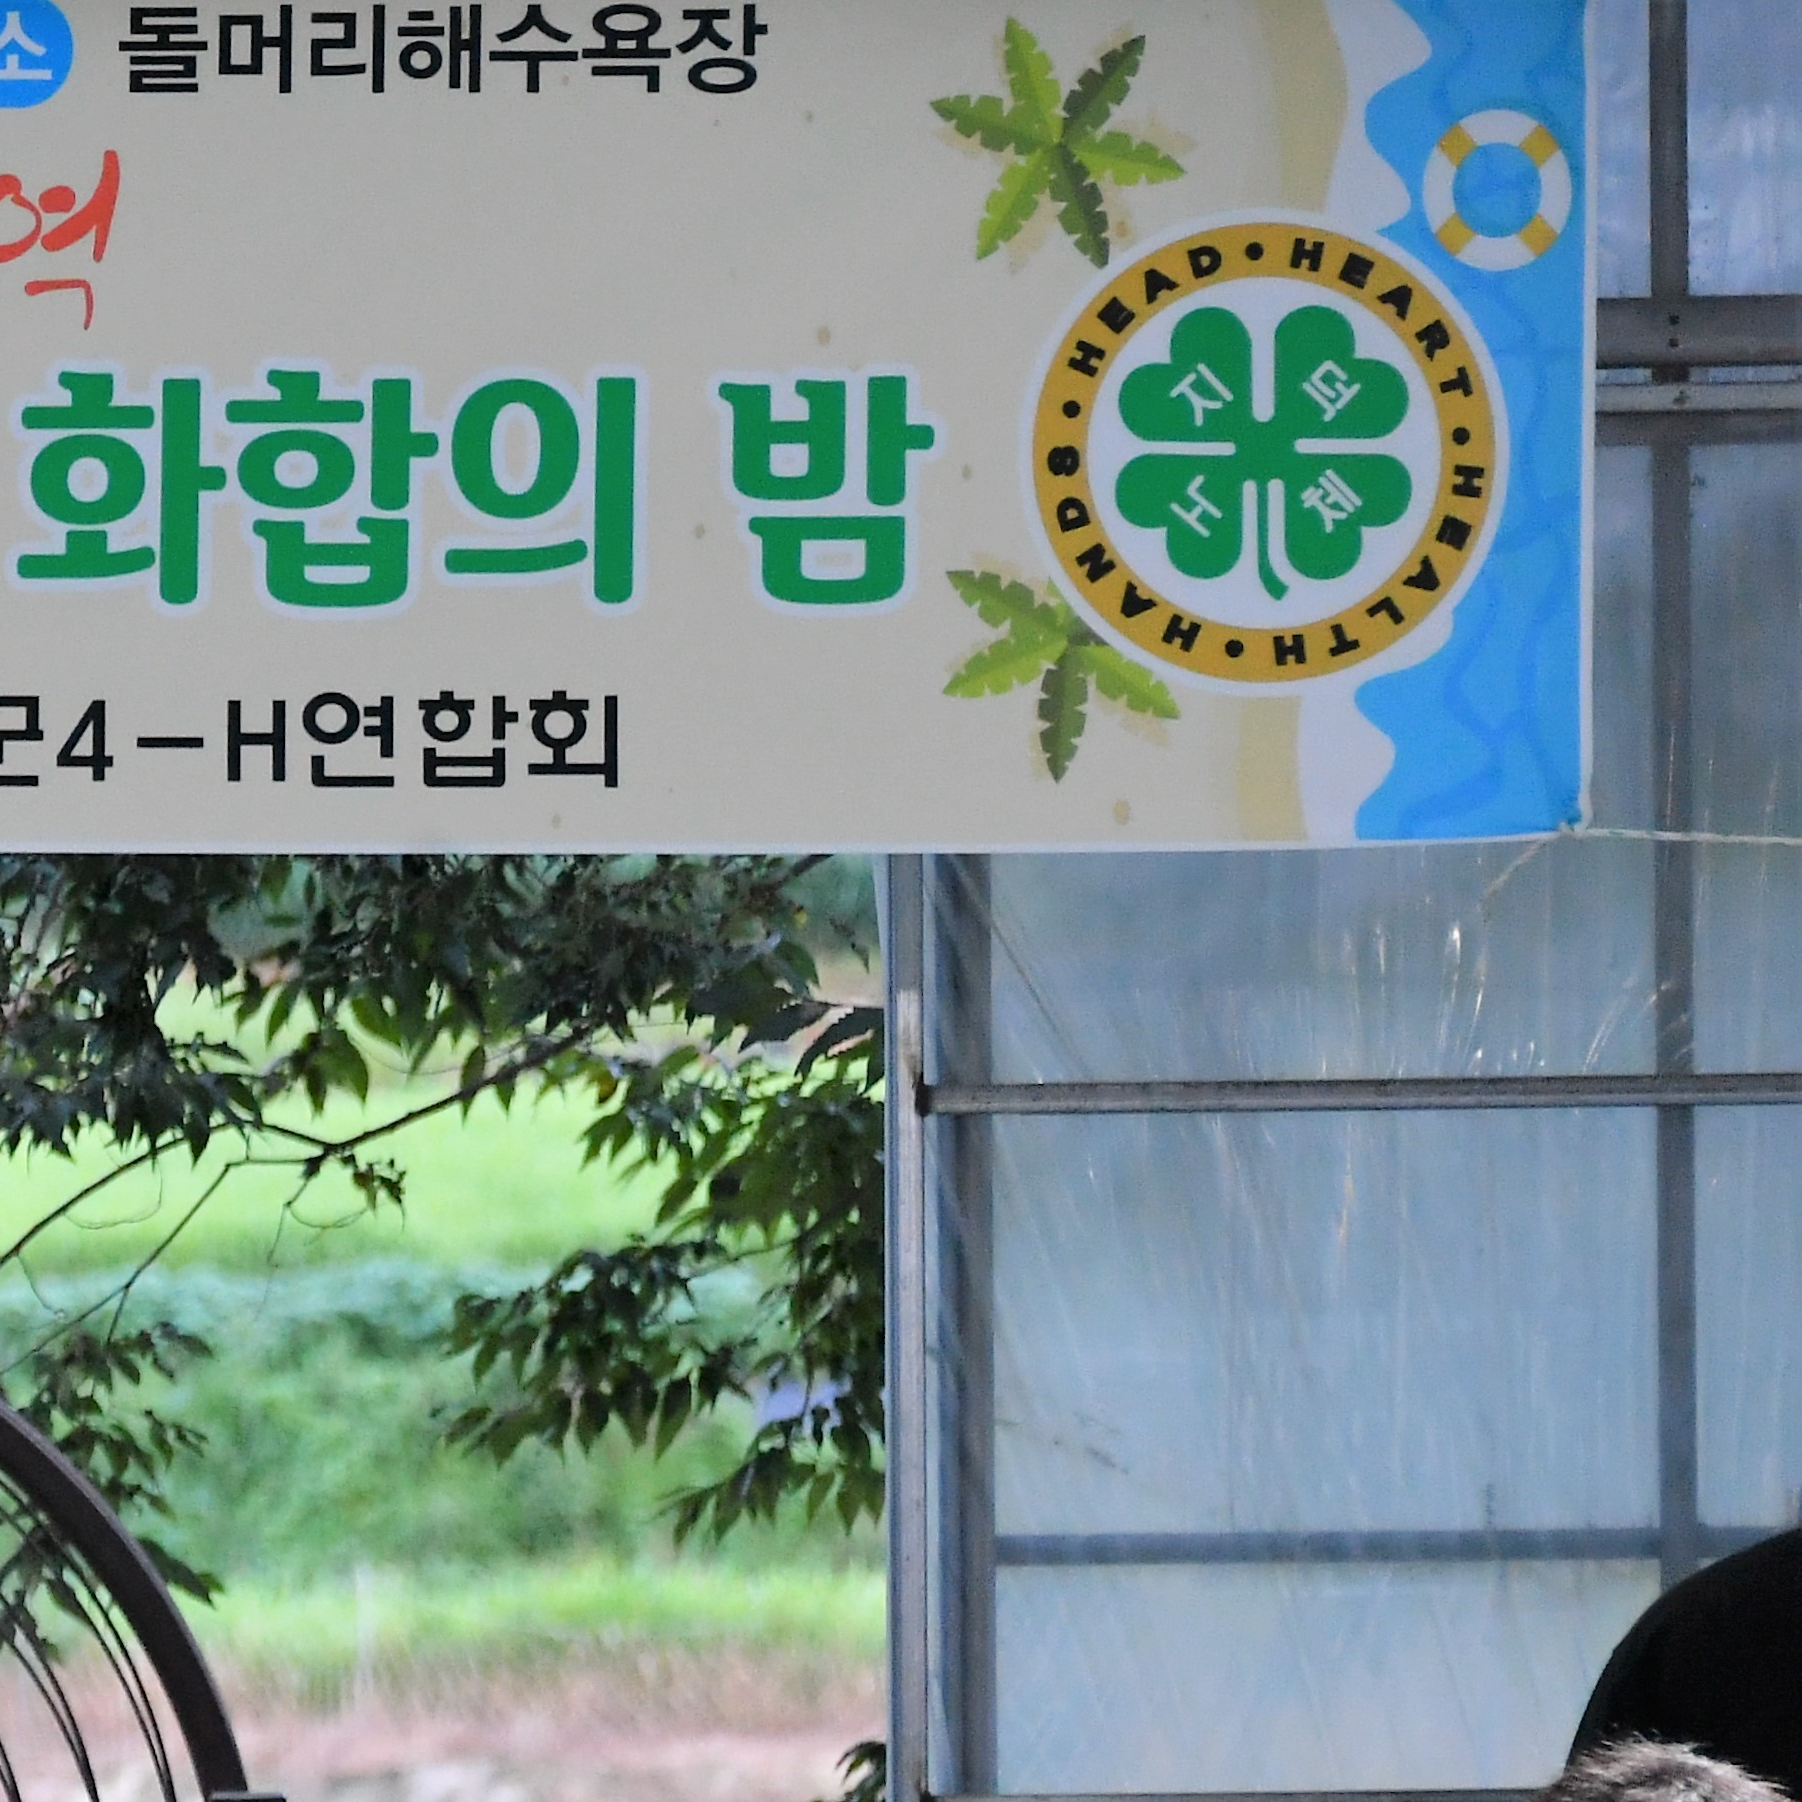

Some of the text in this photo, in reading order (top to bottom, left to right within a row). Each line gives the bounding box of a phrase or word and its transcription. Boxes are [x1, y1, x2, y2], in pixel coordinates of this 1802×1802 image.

[118, 3, 769, 94] 돌머리해수욕장
[1067, 246, 1223, 379] HEAD
[1290, 237, 1474, 399] HEART
[1170, 363, 1235, 427] 지
[16, 368, 638, 608] 화합의
[717, 374, 936, 606] 밤
[1272, 464, 1486, 667] HEALTH
